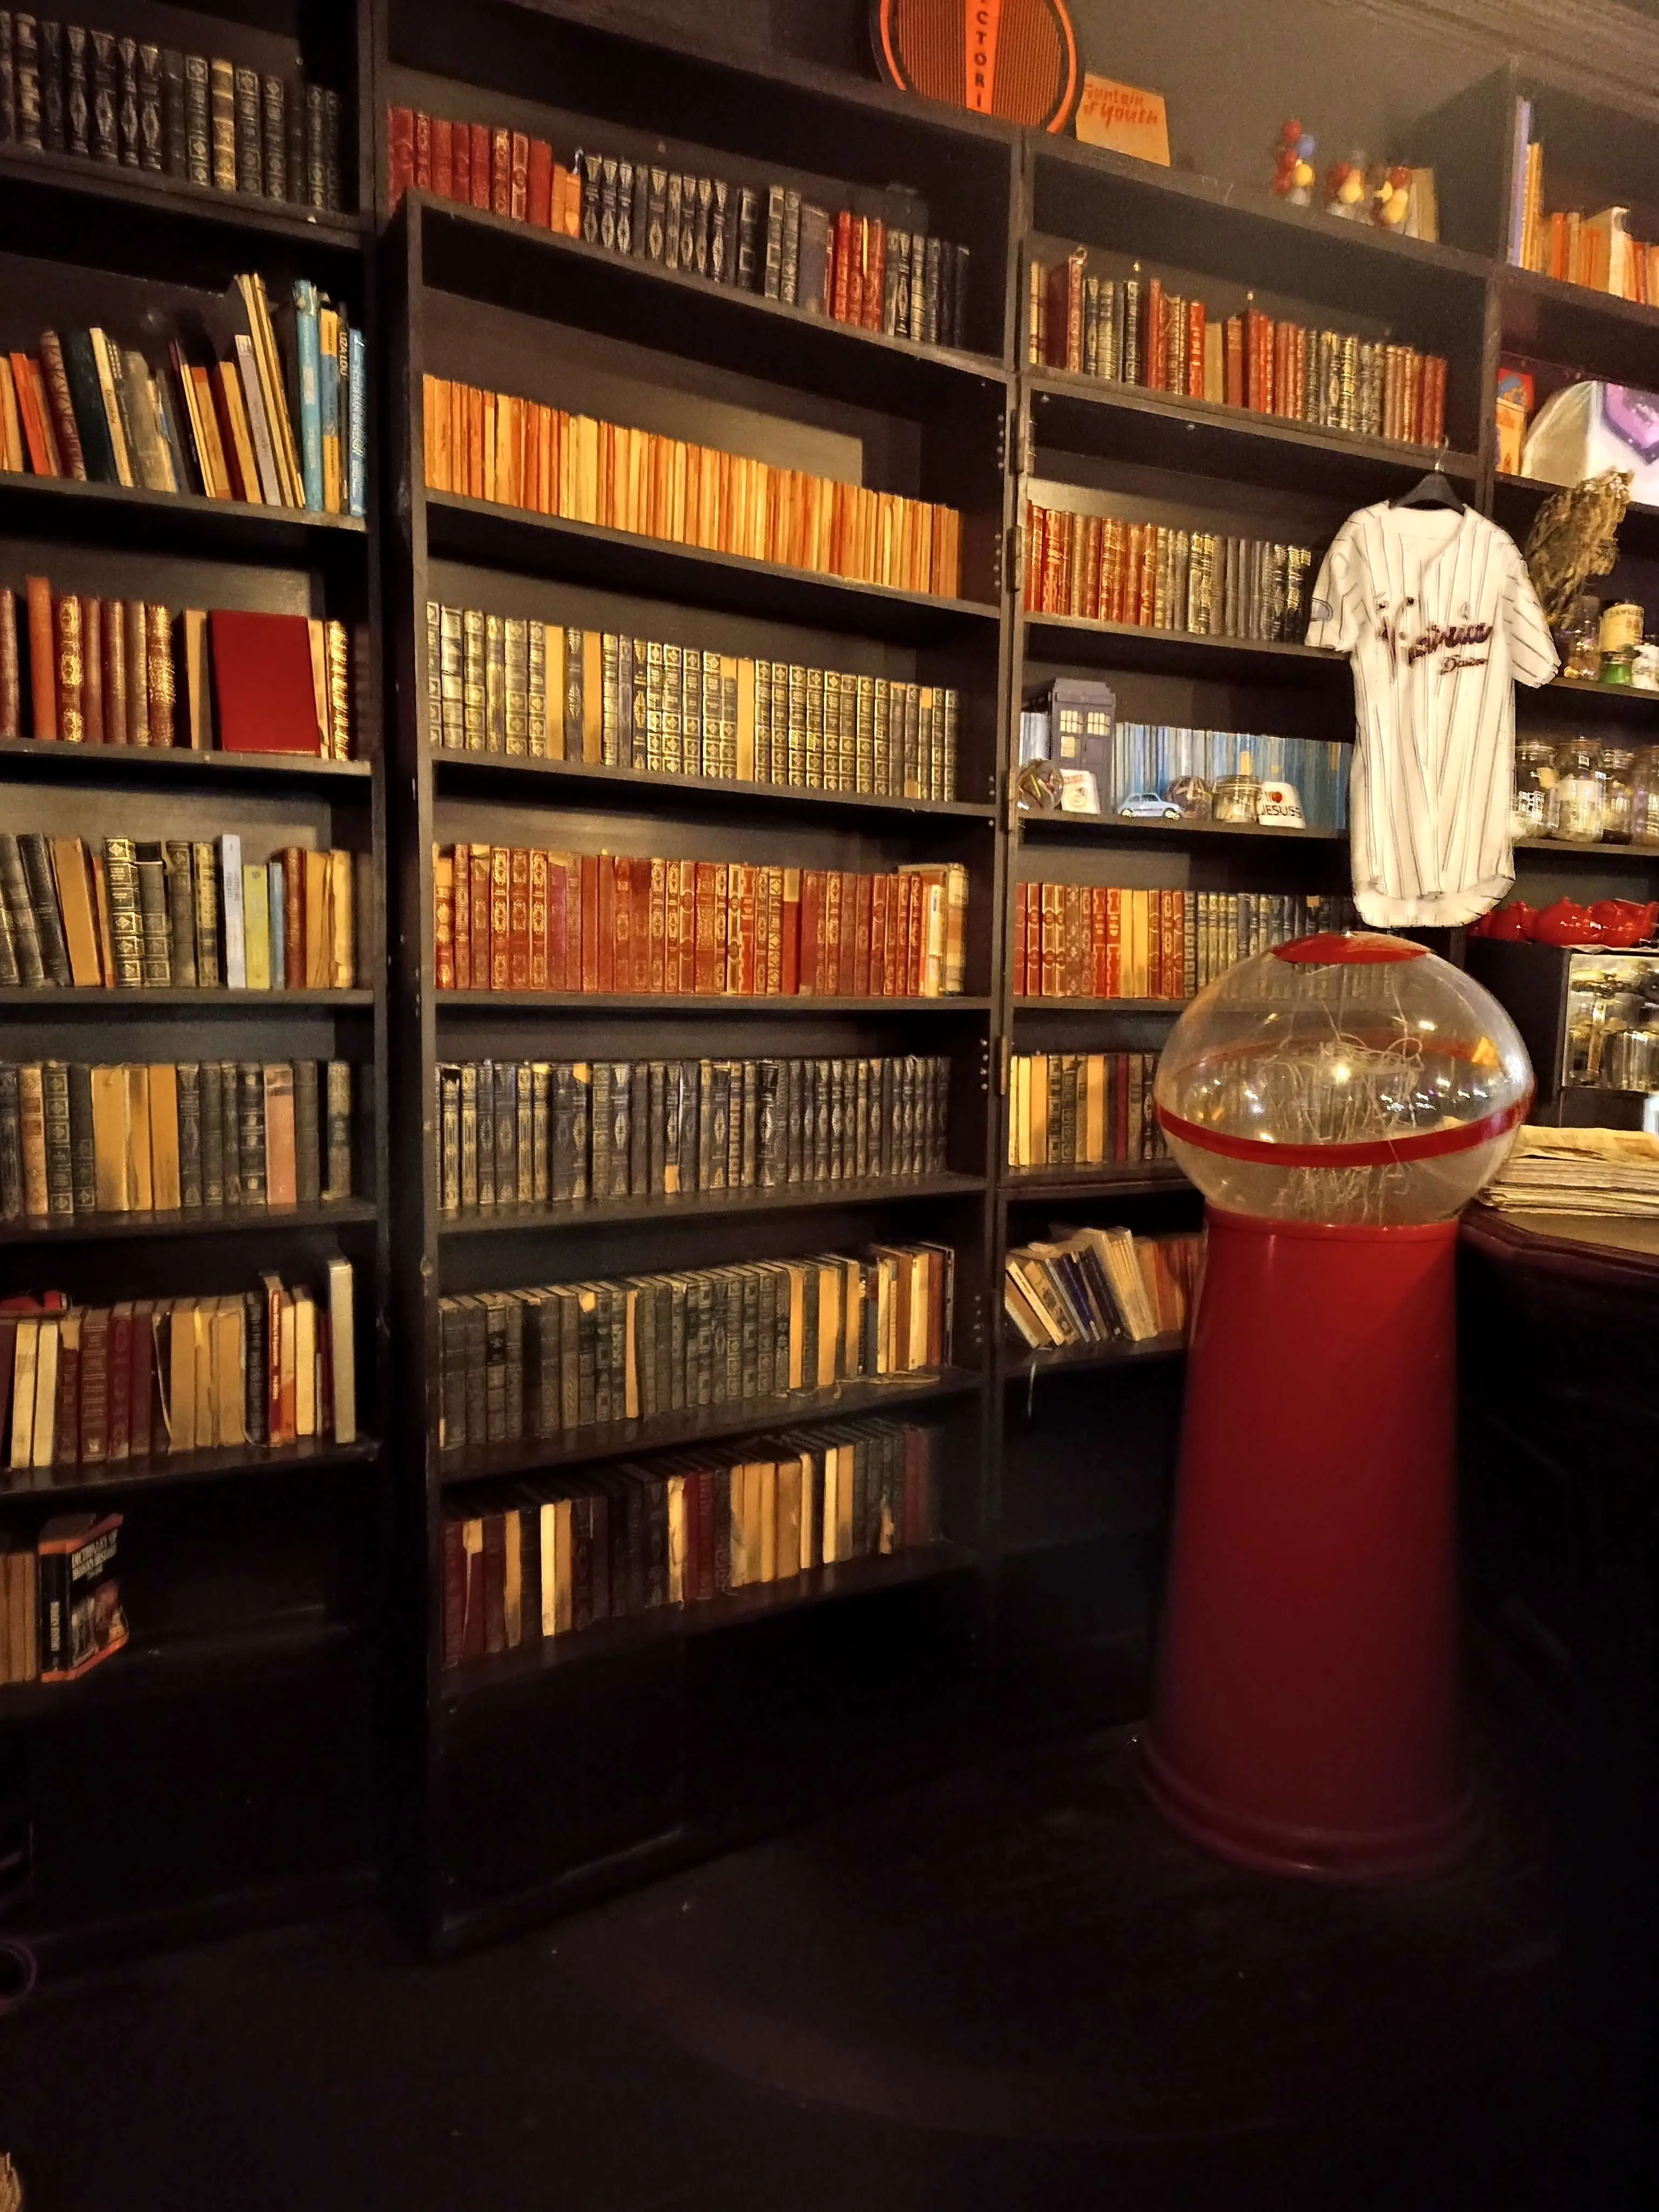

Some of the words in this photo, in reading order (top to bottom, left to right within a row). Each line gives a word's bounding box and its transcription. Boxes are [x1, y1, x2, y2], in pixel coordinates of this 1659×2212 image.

[974, 0, 988, 107] CTORI
[339, 355, 348, 376] LOU
[1257, 804, 1303, 819] JESUS
